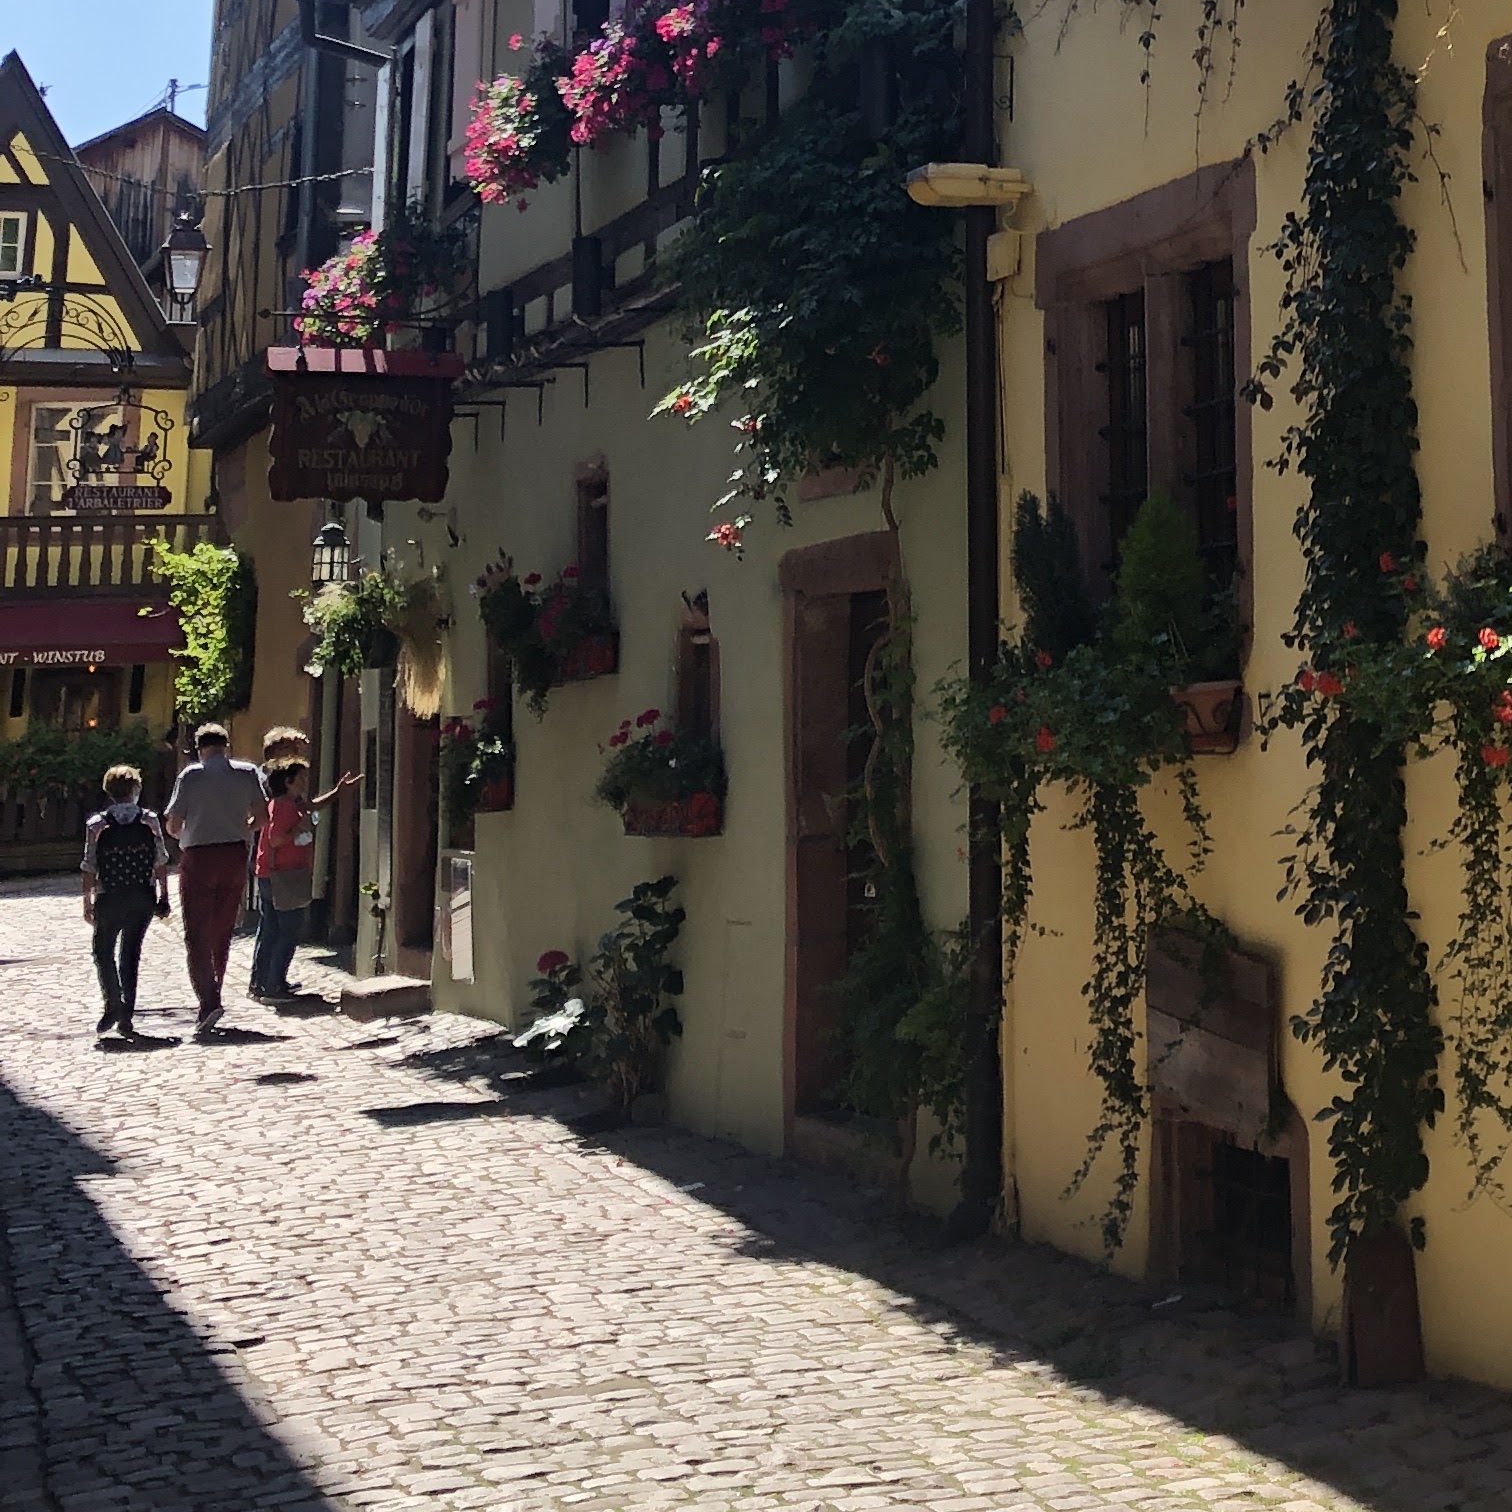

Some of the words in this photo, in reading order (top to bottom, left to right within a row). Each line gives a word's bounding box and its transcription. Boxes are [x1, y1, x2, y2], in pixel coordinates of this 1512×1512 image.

[297, 447, 422, 469] RESTAURANT
[74, 487, 160, 498] RESTAURANT
[32, 649, 106, 664] WINSTUB
